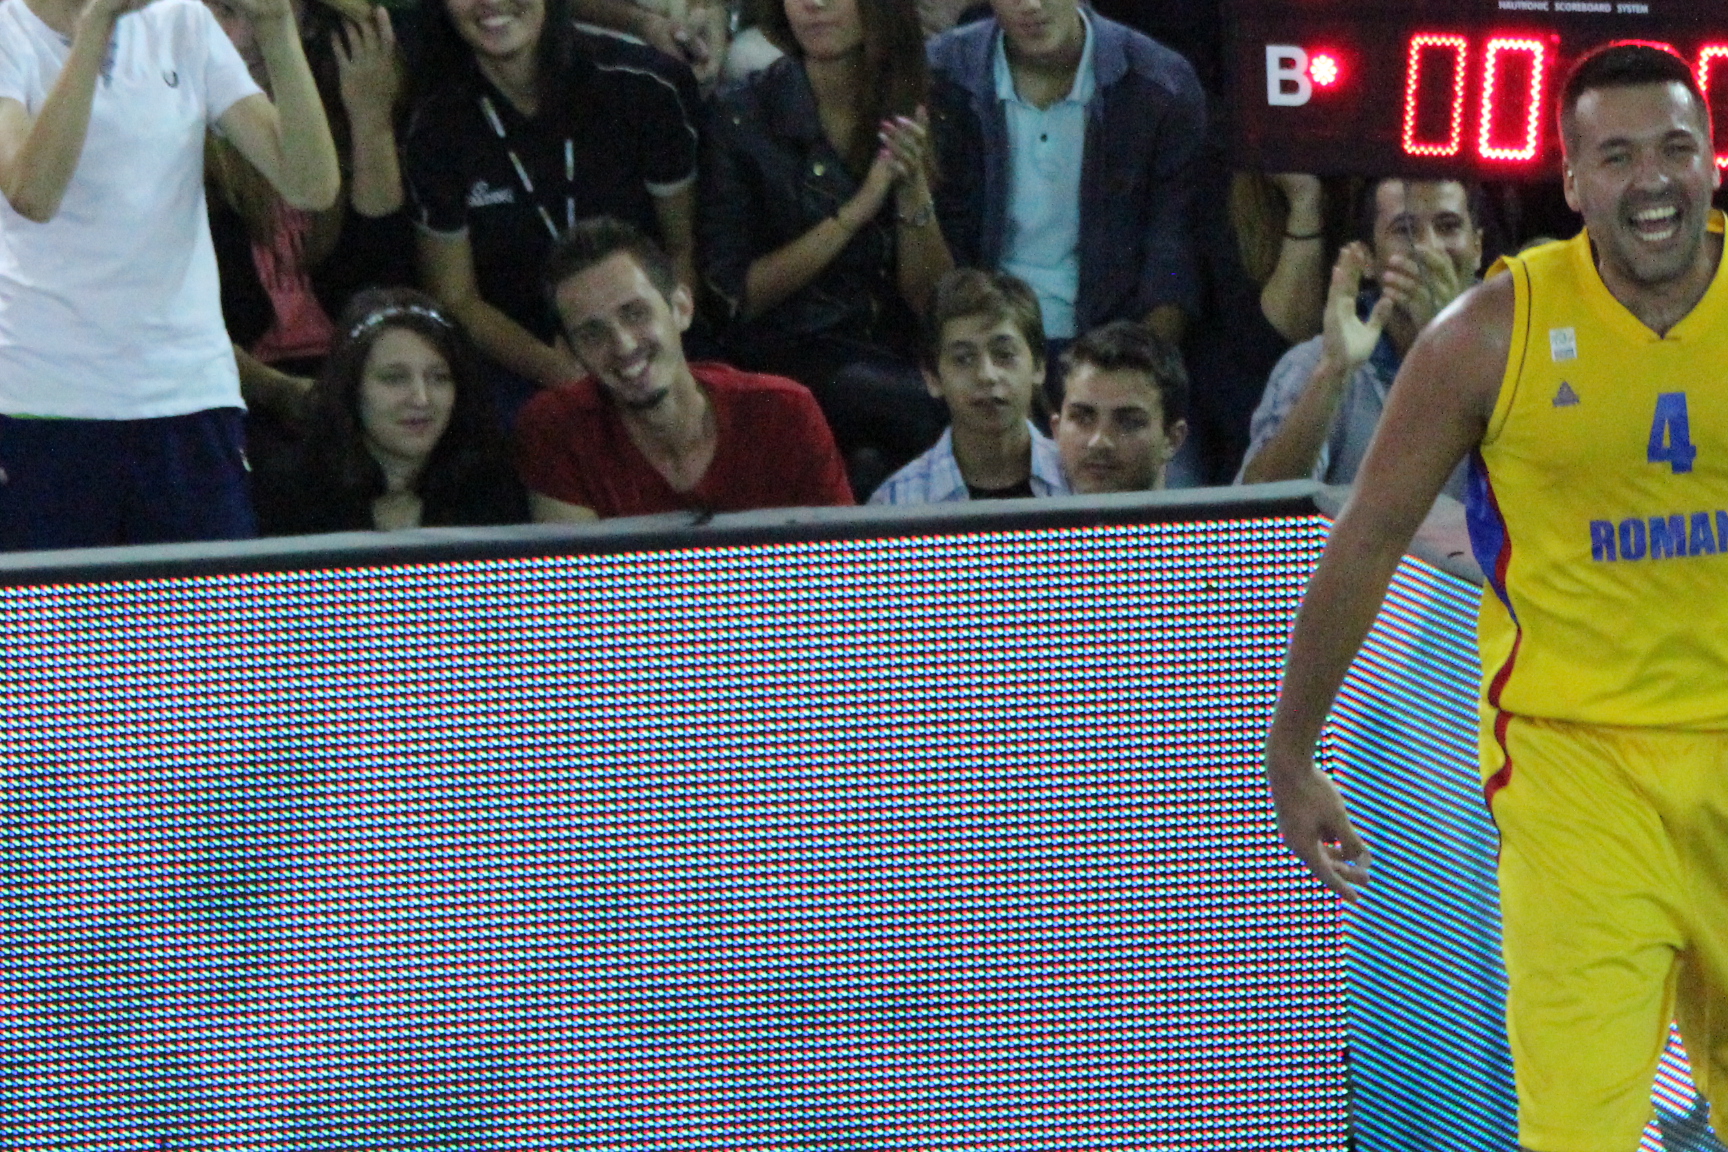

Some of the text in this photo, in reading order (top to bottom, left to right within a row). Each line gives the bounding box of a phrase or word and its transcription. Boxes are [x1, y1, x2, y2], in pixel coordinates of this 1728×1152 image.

[1554, 1, 1612, 13] SCOREBOARD
[1616, 3, 1649, 14] SYSTEM
[1266, 45, 1312, 107] B
[1647, 392, 1697, 474] 4
